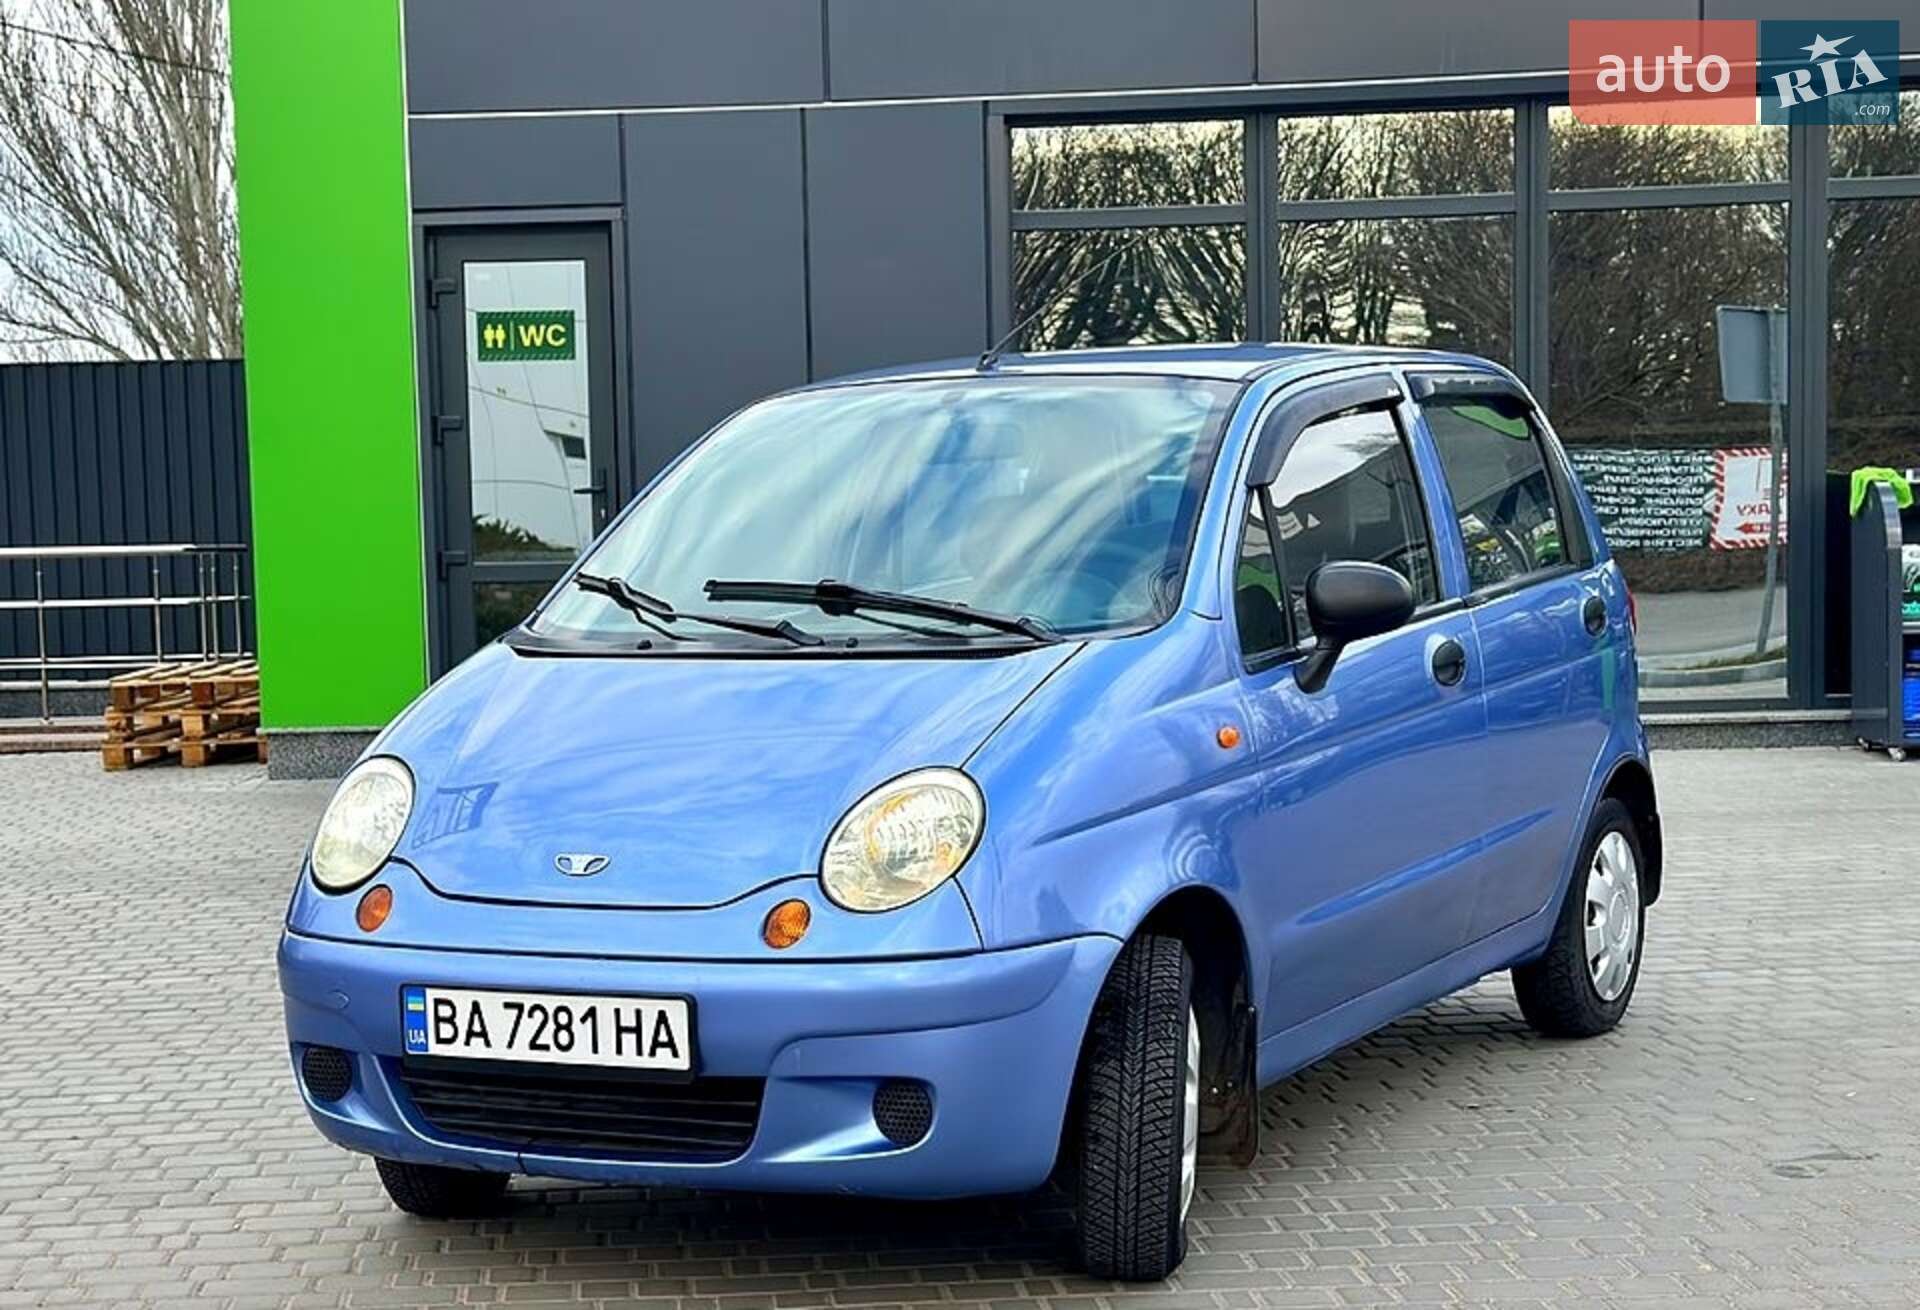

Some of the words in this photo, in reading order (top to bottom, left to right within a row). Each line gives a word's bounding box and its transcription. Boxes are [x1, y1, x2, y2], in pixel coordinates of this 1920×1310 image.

[518, 323, 566, 347] WC
[408, 1029, 426, 1045] UA
[433, 998, 492, 1048] BA
[503, 1001, 599, 1055] 7281
[614, 1008, 680, 1058] HA
